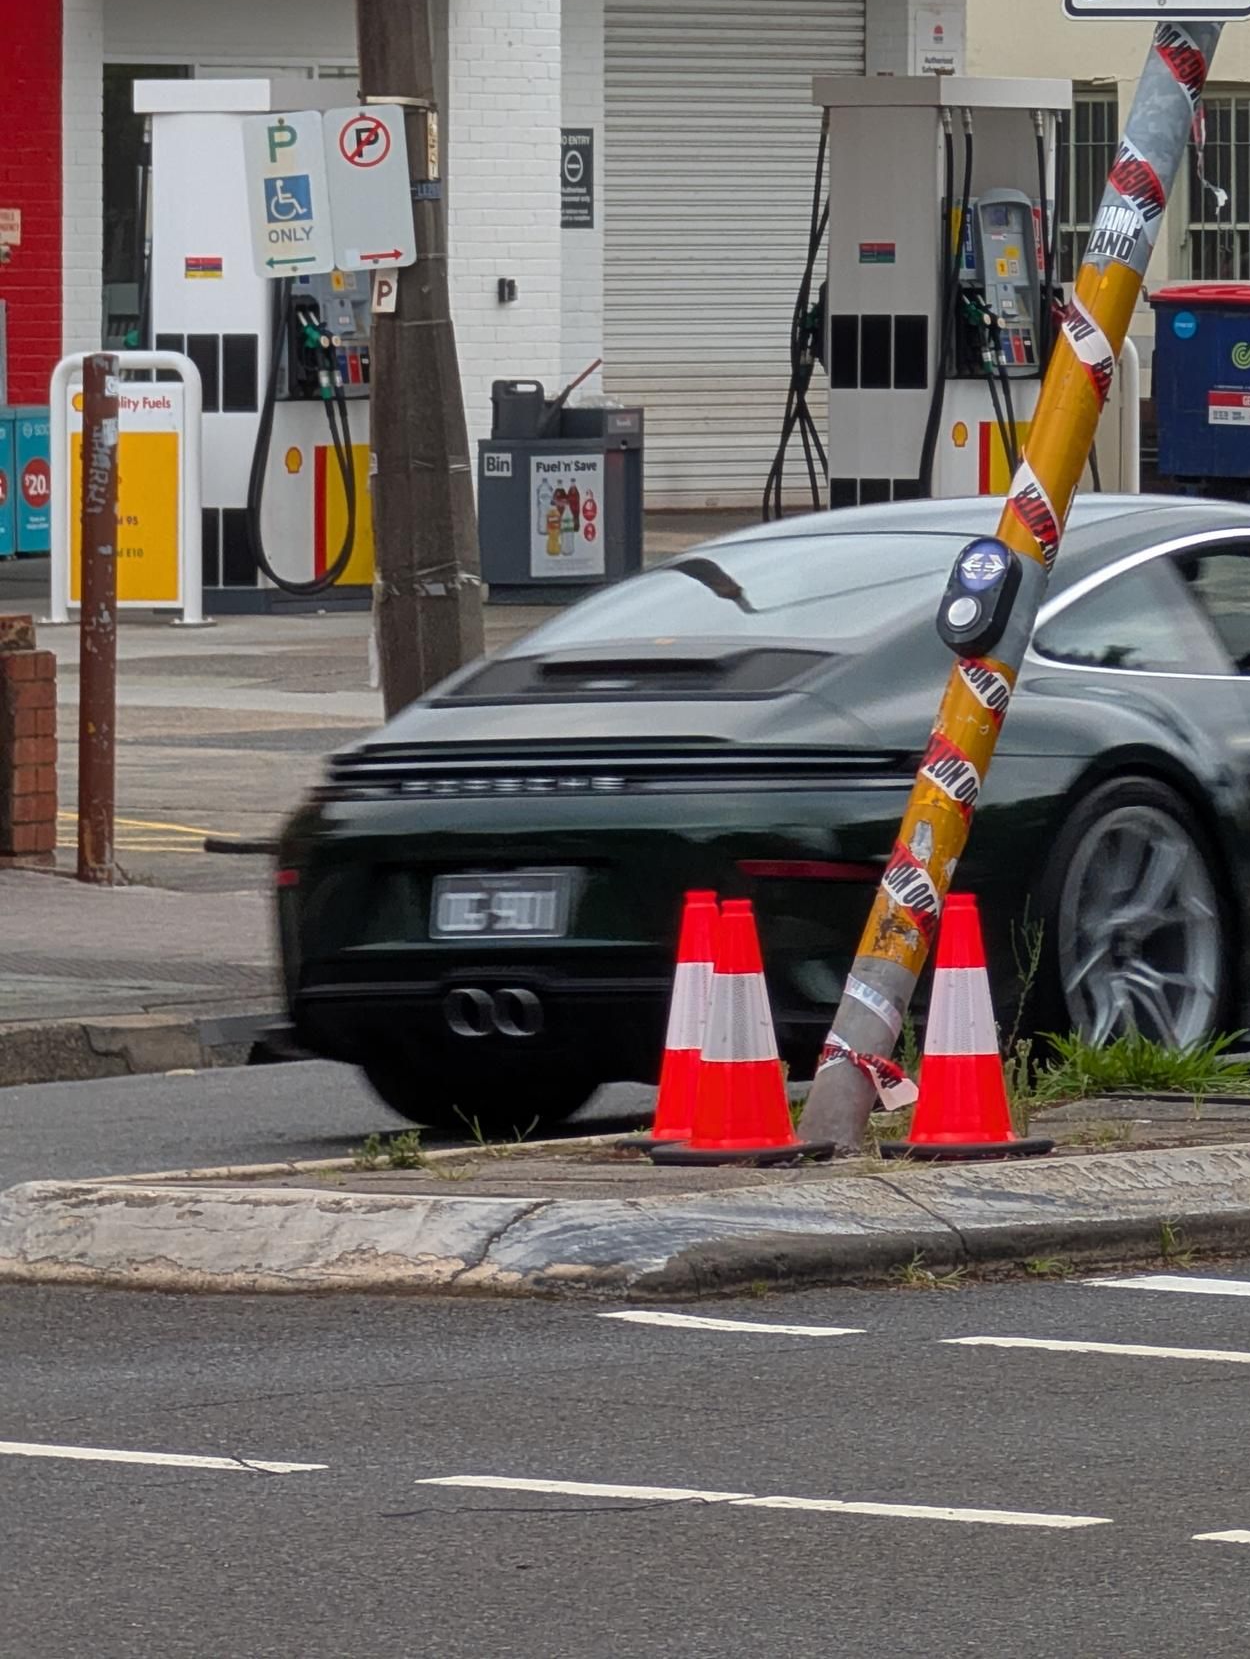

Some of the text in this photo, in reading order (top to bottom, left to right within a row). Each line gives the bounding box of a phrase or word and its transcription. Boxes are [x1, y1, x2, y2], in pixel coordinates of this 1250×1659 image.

[266, 125, 298, 163] P
[268, 226, 314, 244] ONLY
[376, 280, 392, 307] P
[142, 396, 171, 410] Fuels
[486, 455, 511, 473] Bin
[536, 461, 561, 474] Fuel
[574, 460, 598, 472] Save
